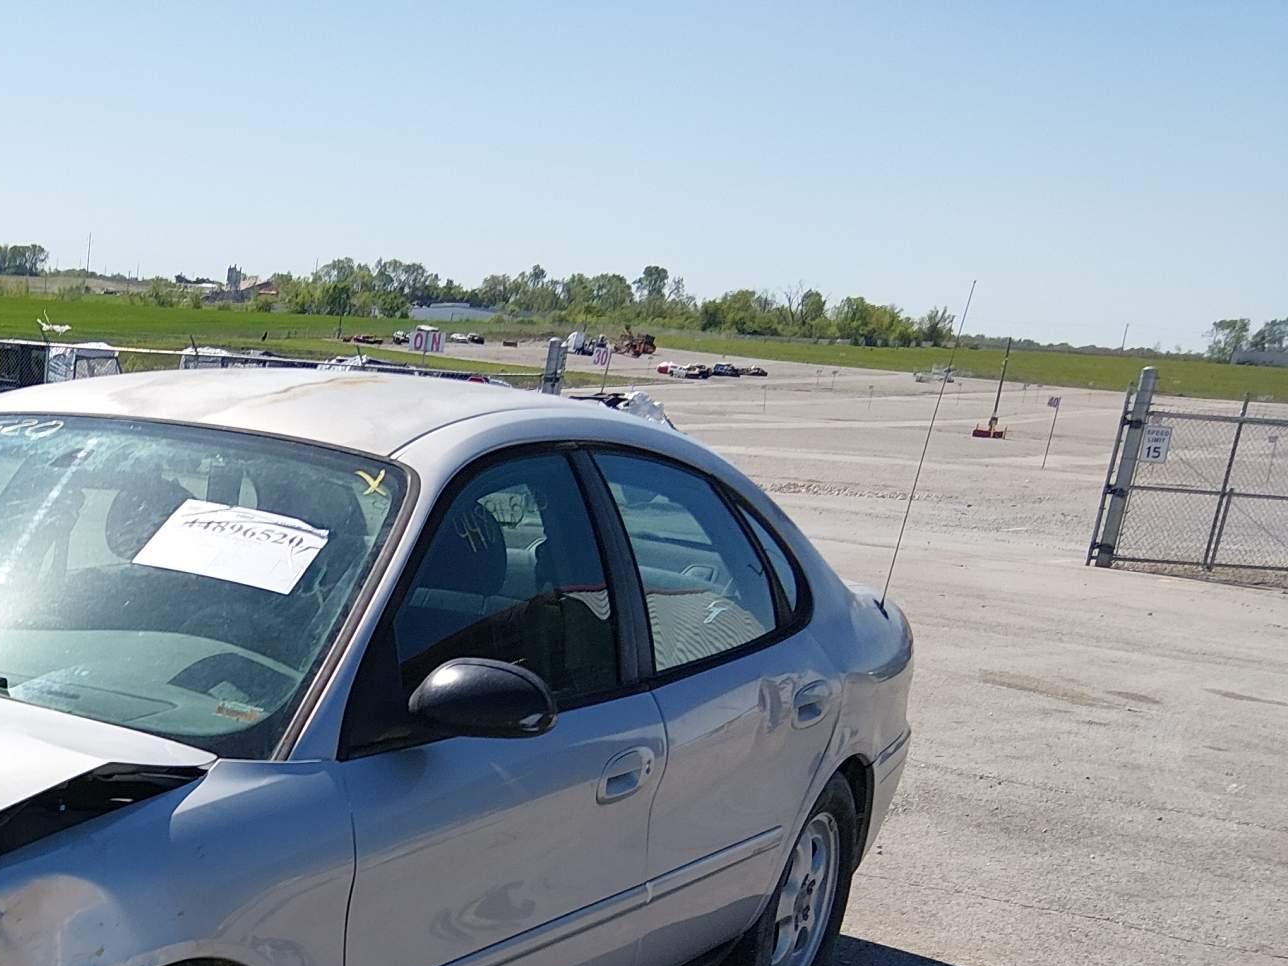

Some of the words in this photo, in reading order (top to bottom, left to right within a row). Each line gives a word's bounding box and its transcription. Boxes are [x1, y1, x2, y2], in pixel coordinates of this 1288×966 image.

[1146, 429, 1170, 437] SPEED
[1145, 446, 1161, 459] 15
[183, 517, 305, 547] 44896520
